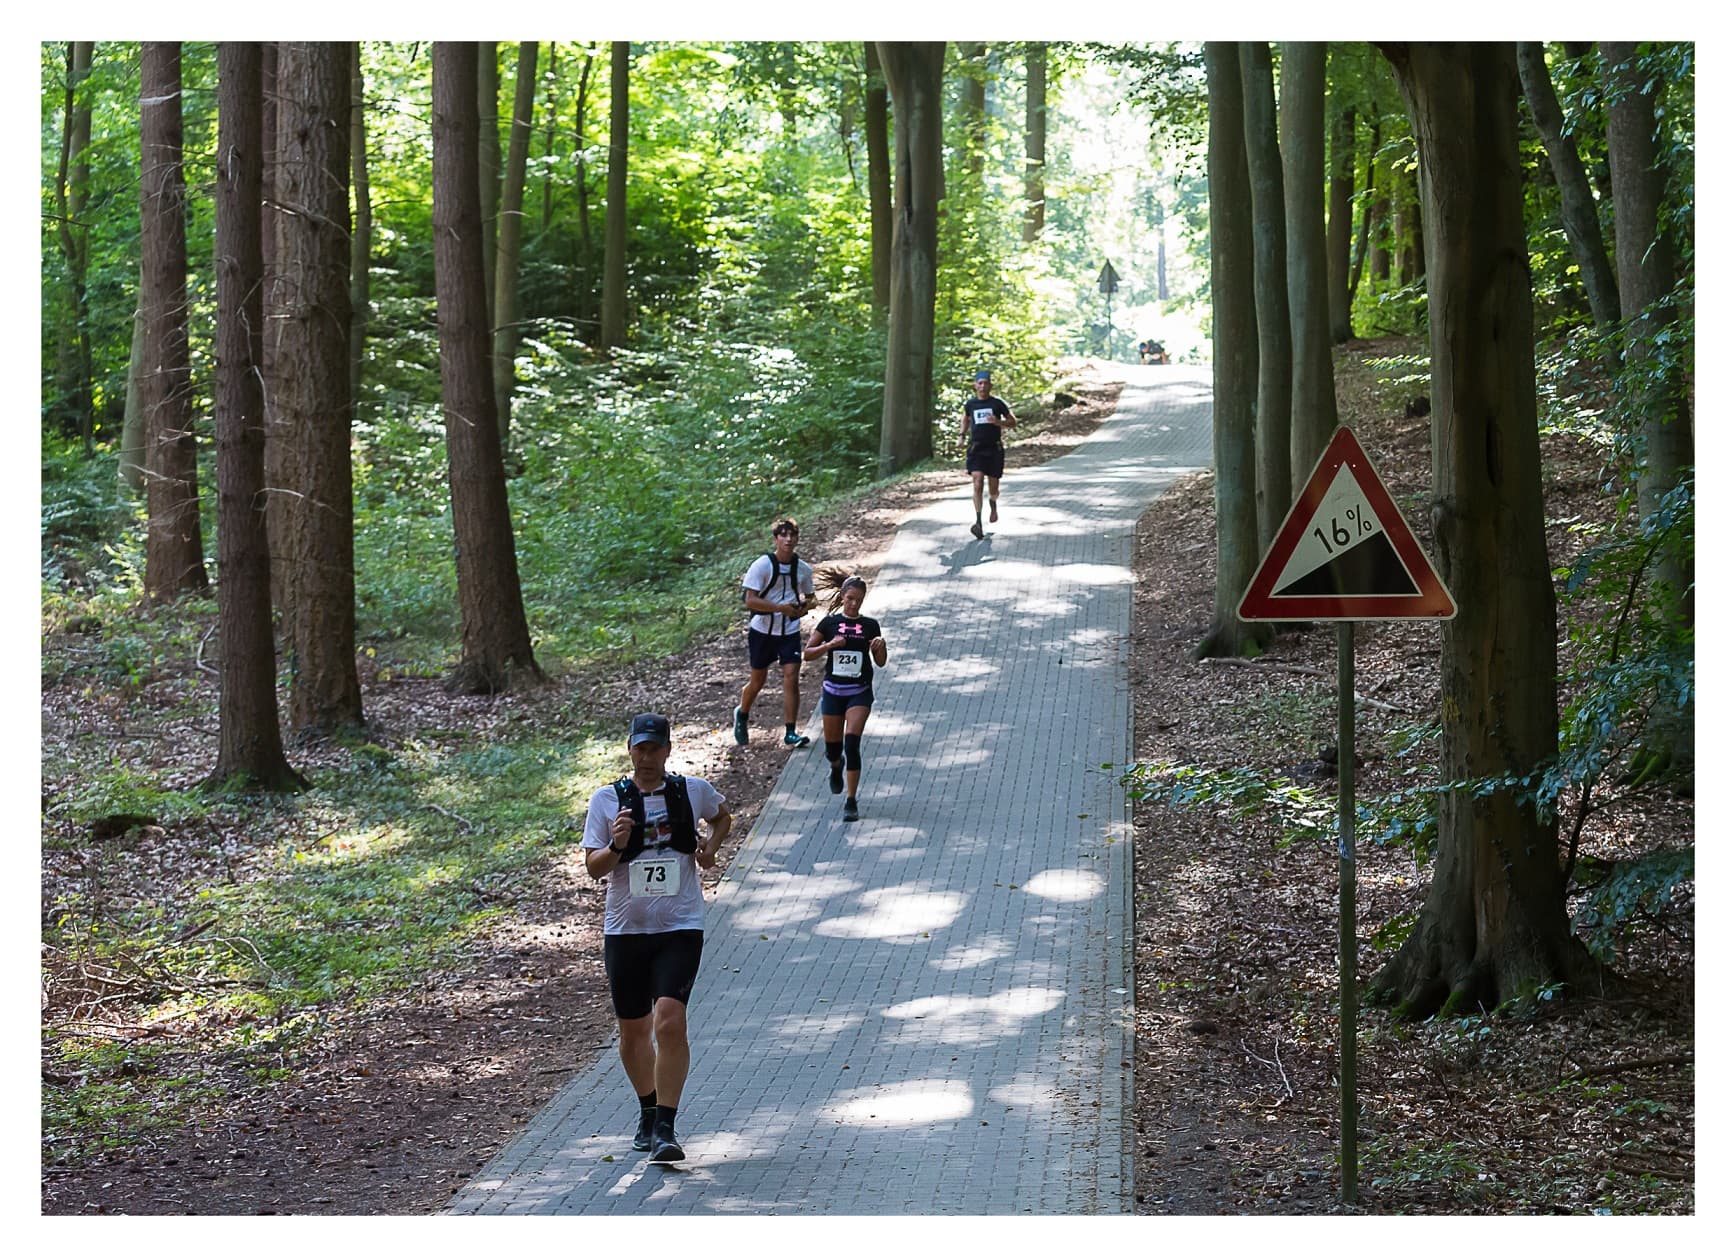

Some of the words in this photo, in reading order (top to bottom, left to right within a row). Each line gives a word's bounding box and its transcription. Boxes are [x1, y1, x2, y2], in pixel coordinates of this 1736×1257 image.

[1313, 504, 1372, 554] 16%
[838, 655, 857, 664] 234
[644, 866, 666, 882] 73
